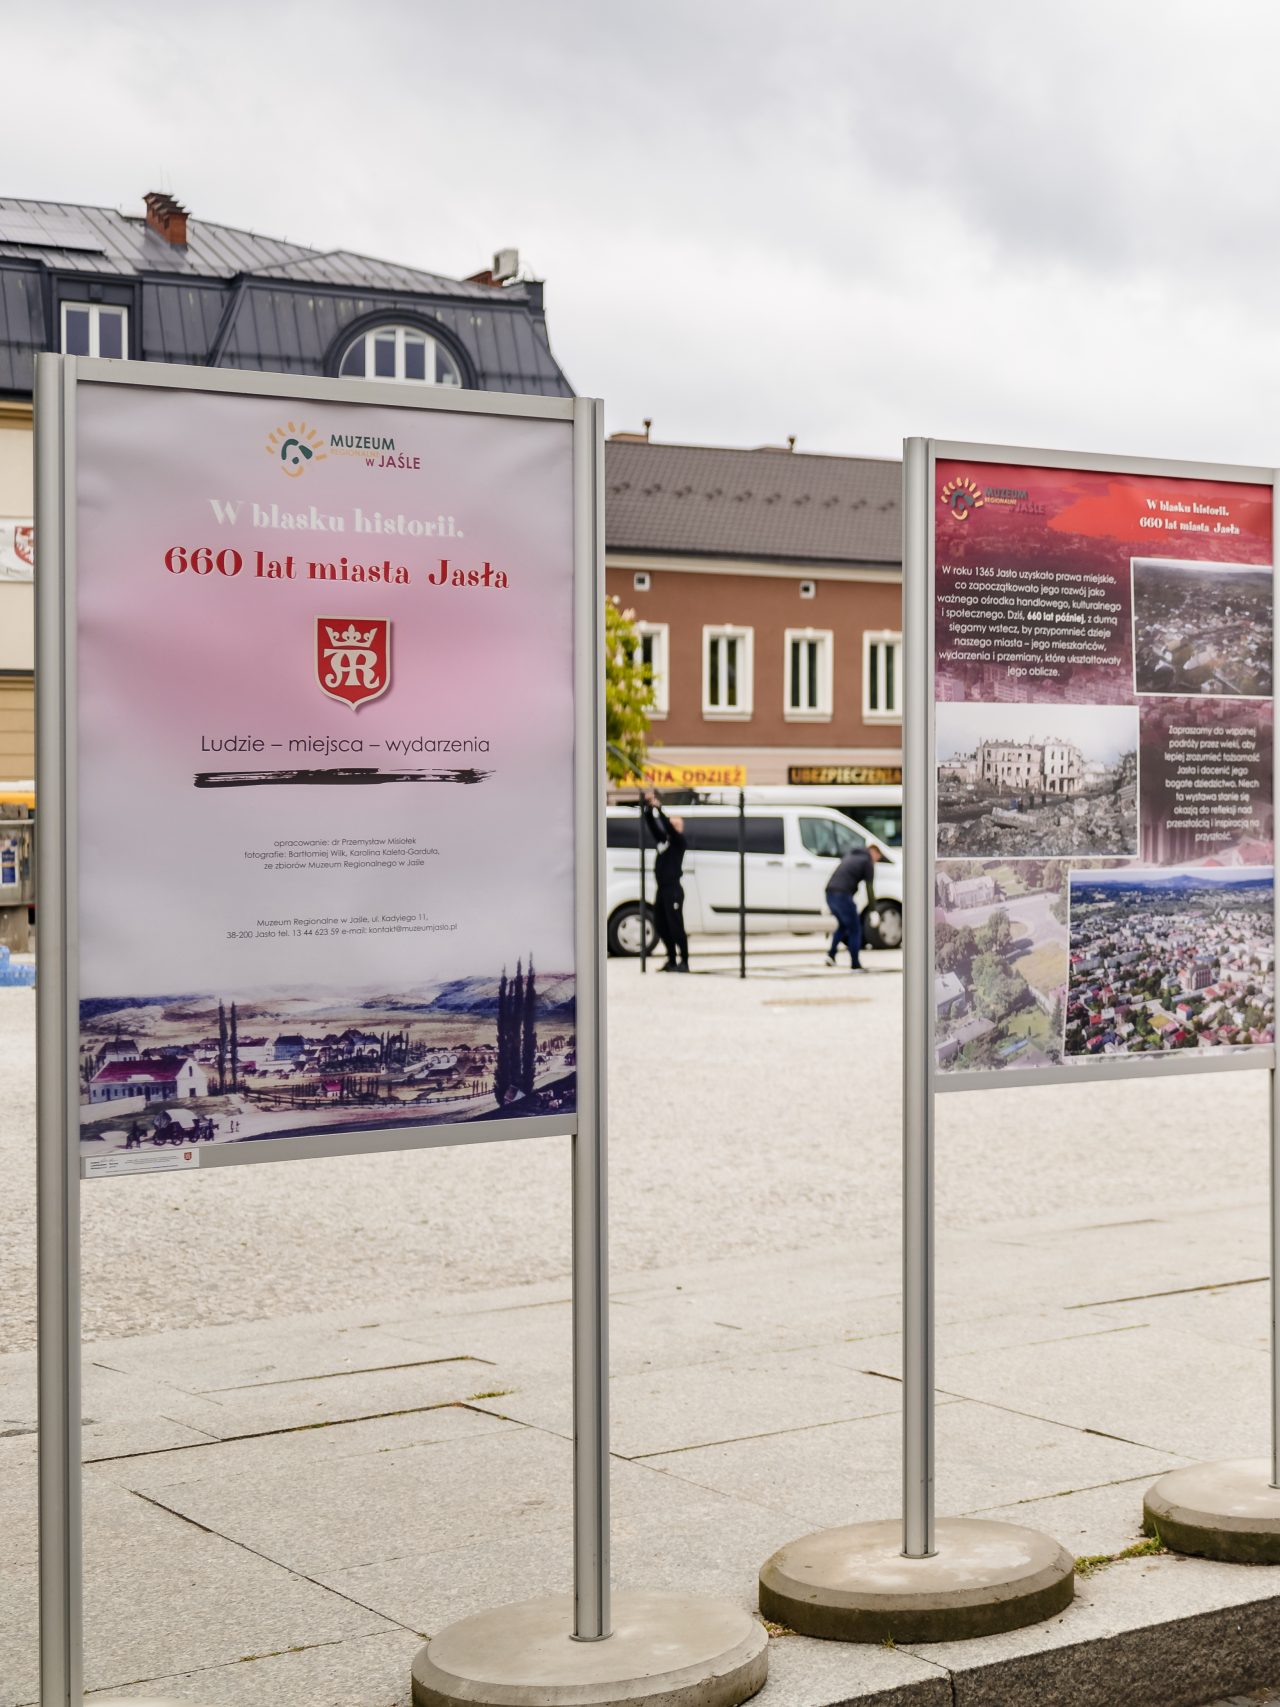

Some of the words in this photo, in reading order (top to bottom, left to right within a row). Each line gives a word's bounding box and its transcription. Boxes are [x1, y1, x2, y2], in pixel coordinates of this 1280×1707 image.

[330, 434, 395, 451] MUZEUM
[378, 452, 421, 470] JAŚLE
[985, 487, 1028, 499] MUZEUM
[1146, 498, 1157, 510] W
[1160, 500, 1191, 513] blasku
[1193, 502, 1230, 516] historii.
[209, 498, 243, 525] W
[252, 503, 345, 533] blasku
[354, 508, 464, 538] historii.
[1139, 516, 1163, 529] 660
[1164, 518, 1177, 530] lat
[1179, 521, 1210, 532] miasta
[1213, 522, 1240, 535] Jasła
[164, 546, 243, 577] 660
[254, 551, 297, 580] lat
[306, 557, 412, 585] miasta
[428, 559, 510, 589] Jasła
[941, 565, 952, 575] W
[953, 566, 973, 576] roku
[975, 566, 995, 577] 1365
[996, 568, 1018, 578] Jasło
[1018, 570, 1055, 581] uzyskało
[1055, 572, 1082, 582] prawa
[1083, 573, 1117, 585] miejskie,
[954, 581, 967, 590] co
[968, 581, 1040, 593] zapoczątkowało
[1040, 584, 1060, 596] jego
[1061, 586, 1087, 598] rozwój
[1087, 586, 1106, 598] jako
[936, 593, 979, 606] ważnego
[980, 594, 1015, 606] ośrodka
[1016, 596, 1071, 610] handlowego,
[1072, 599, 1122, 613] kulturalnego
[945, 608, 1006, 621] społecznego.
[1007, 610, 1025, 621] Dziś,
[1026, 611, 1043, 621] 660
[1043, 611, 1054, 621] lat
[1087, 615, 1093, 623] z
[1093, 614, 1118, 626] dumą
[948, 622, 987, 634] sięgamy
[988, 623, 1020, 635] wstecz,
[1021, 624, 1033, 636] by
[1034, 626, 1087, 637] przypomnieć
[1087, 627, 1112, 639] dzieje
[954, 637, 992, 649] naszego
[993, 637, 1023, 648] miasta
[1031, 638, 1050, 650] jego
[1051, 640, 1107, 652] mieszkańców,
[938, 650, 991, 661] wydarzenia
[997, 651, 1043, 663] przemiany,
[1044, 653, 1066, 663] które
[1067, 654, 1122, 667] ukształtowały
[1007, 665, 1027, 677] jego
[1028, 667, 1060, 677] oblicze.
[1168, 725, 1213, 736] Zapraszamy
[1213, 726, 1224, 735] do
[201, 735, 265, 752] Ludzie
[288, 735, 363, 756] miejsca
[385, 736, 490, 756] wydarzenia
[1199, 740, 1219, 750] przez
[1241, 740, 1256, 751] aby
[1164, 751, 1185, 763] lepiej
[1200, 764, 1231, 775] docenić
[1231, 765, 1249, 777] jego
[1165, 778, 1193, 790] bogate
[1238, 778, 1260, 788] Niech
[1175, 792, 1184, 801] ta
[1184, 792, 1217, 802] wystawa
[1217, 791, 1239, 801] stanie
[1199, 805, 1210, 814] do
[1237, 805, 1253, 814] nad
[273, 839, 330, 848] opracowanie:
[331, 838, 340, 846] dr
[341, 838, 386, 847] Przemysław
[387, 837, 416, 845] Misiołek
[244, 851, 287, 860] fotografie:
[288, 850, 329, 859] Bartłomiej
[330, 849, 347, 857] Wilk,
[349, 849, 381, 857] Karolina
[308, 861, 342, 869] Muzeum
[343, 860, 397, 869] Regionalnego
[256, 919, 291, 927] Muzeum
[293, 918, 338, 927] Regionalne
[226, 931, 253, 939] 38-200
[255, 930, 276, 938] Jasło
[278, 929, 290, 937] tel.
[292, 929, 301, 937] 13
[314, 928, 328, 936] 623
[330, 927, 339, 936] 59
[341, 927, 366, 935] e-mail:
